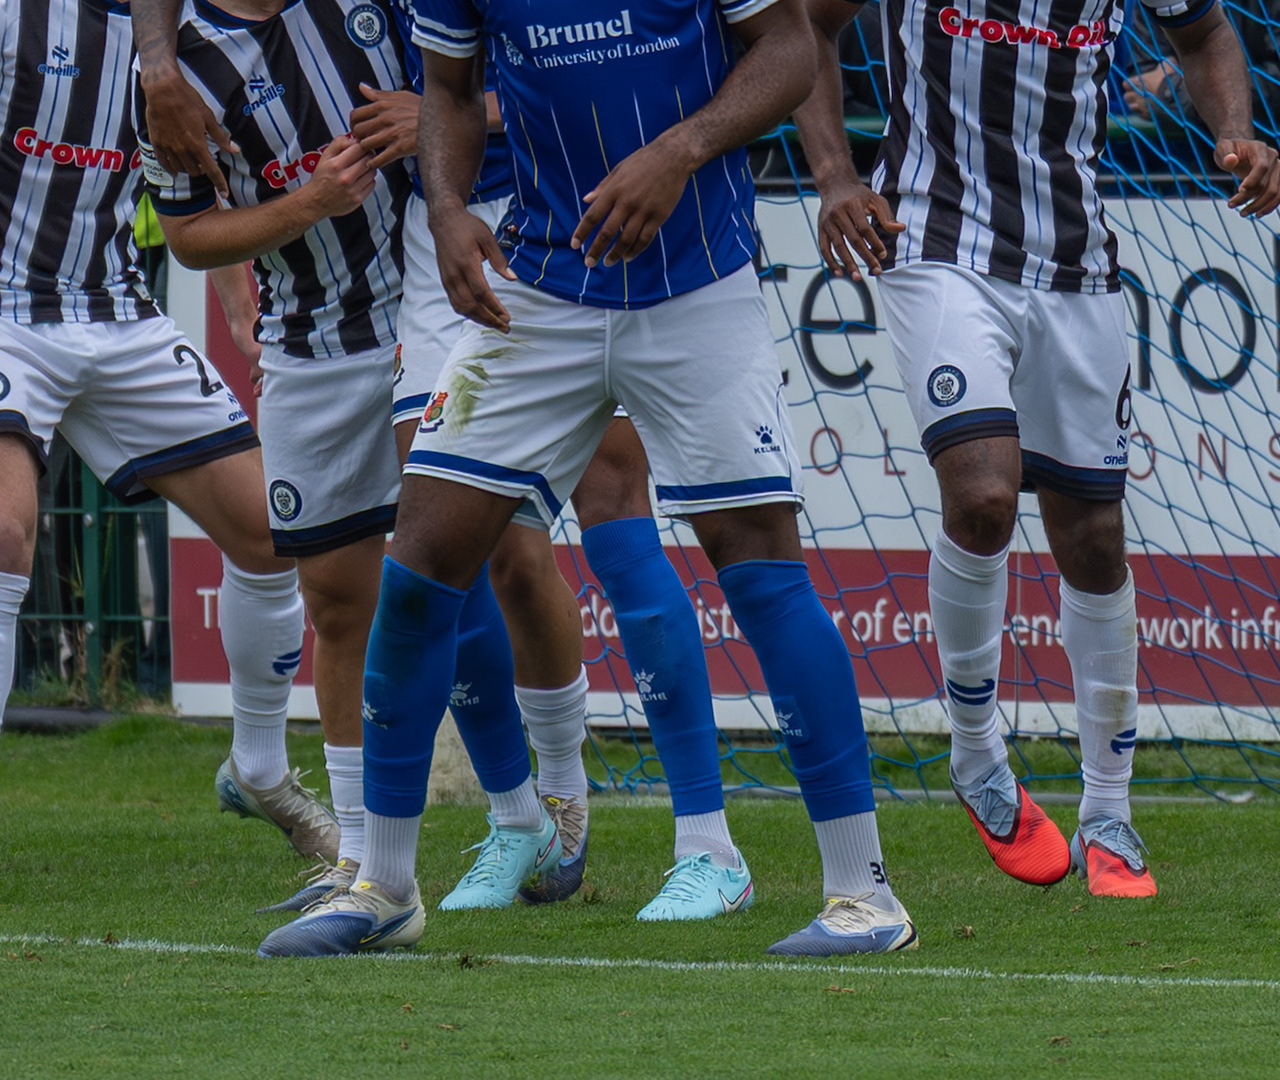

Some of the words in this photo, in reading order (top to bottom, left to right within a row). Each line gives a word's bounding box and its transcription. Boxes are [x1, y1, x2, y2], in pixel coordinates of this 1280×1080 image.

[526, 9, 634, 49] Brunel
[938, 6, 1061, 49] Crown
[533, 47, 607, 70] University
[607, 43, 624, 60] of
[625, 36, 681, 57] London
[14, 126, 125, 173] Crown
[261, 142, 328, 189] Cro
[173, 344, 225, 398] 2
[1115, 362, 1132, 431] 6
[754, 445, 781, 455] KELME
[852, 598, 888, 648] of
[1135, 606, 1223, 651] work
[869, 861, 890, 886] 3
